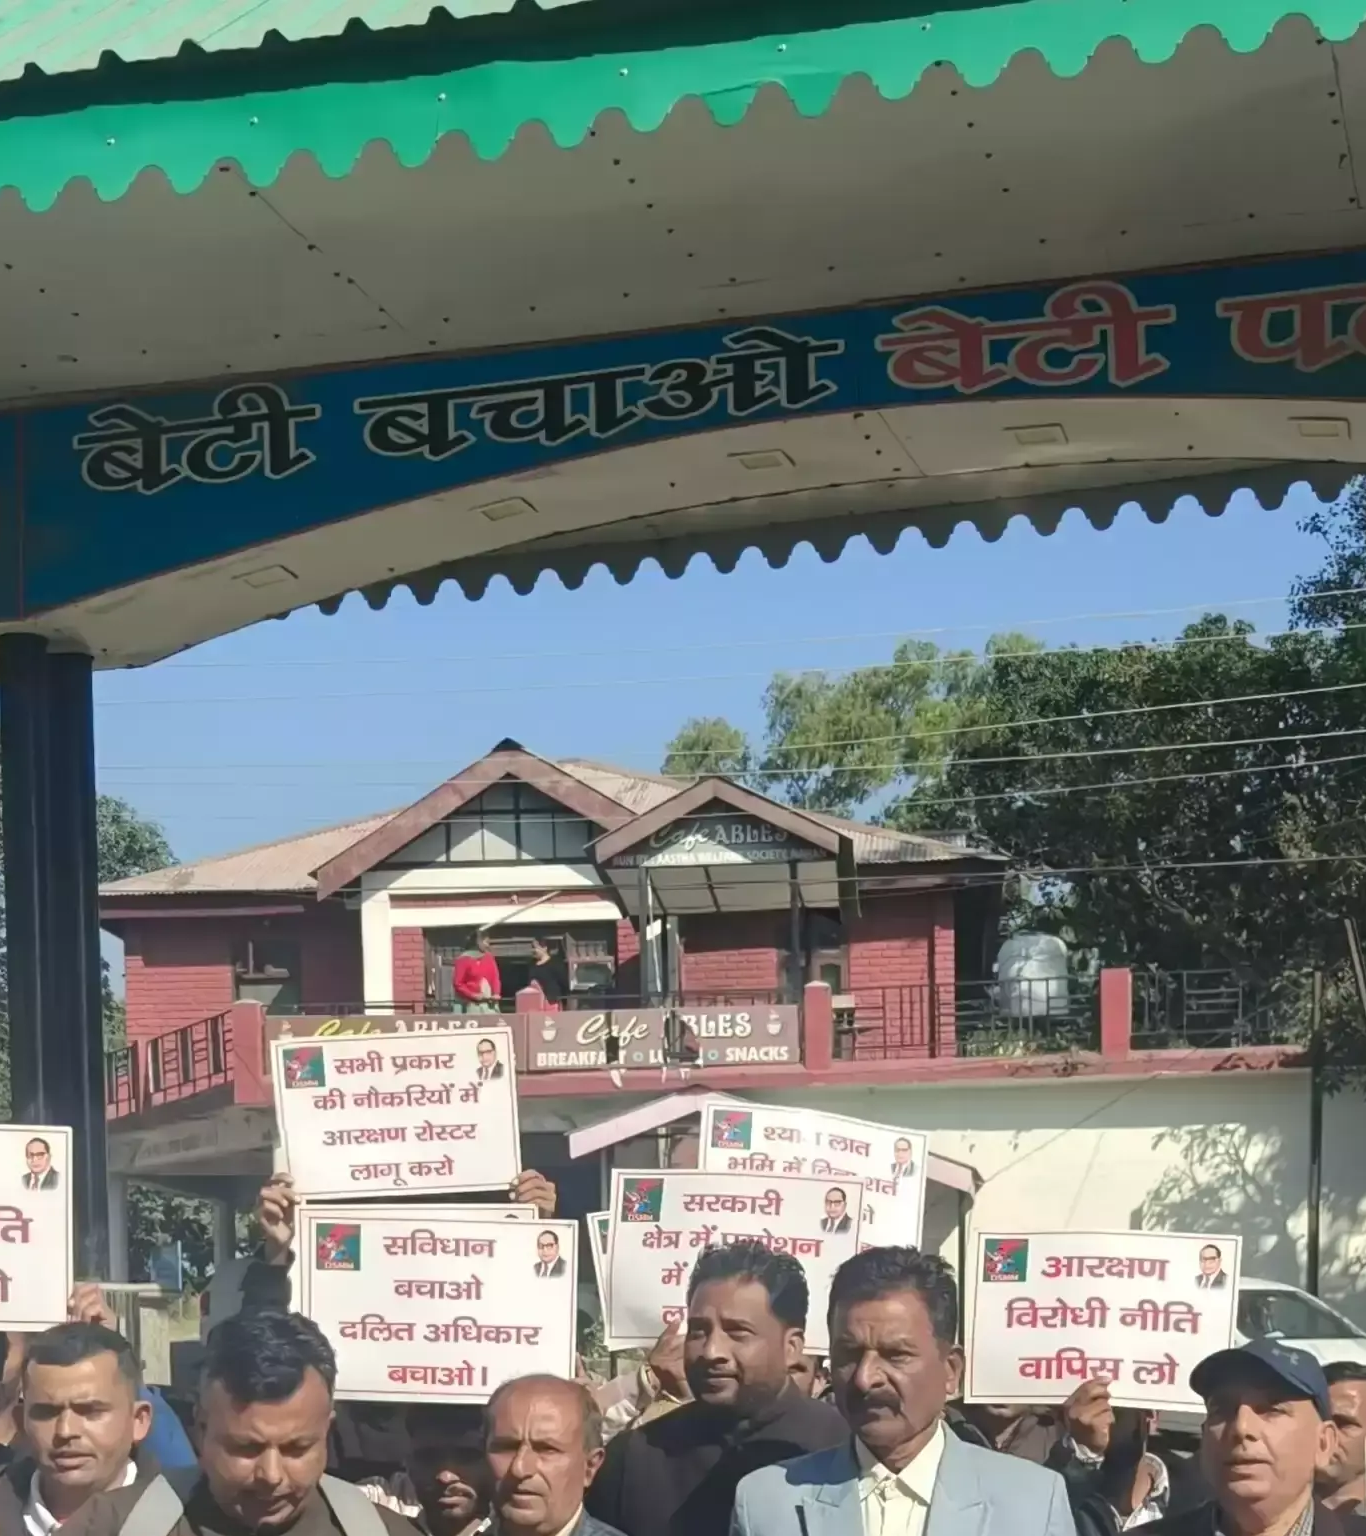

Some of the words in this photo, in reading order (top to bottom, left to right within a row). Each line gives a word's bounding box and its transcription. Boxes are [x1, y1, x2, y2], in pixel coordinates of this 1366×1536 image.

[74, 383, 321, 495] बेटी
[354, 326, 844, 460] बचाओ
[876, 281, 1176, 394] बेटी
[649, 819, 709, 850] Cafe
[334, 1050, 384, 1075] सभी
[391, 1052, 455, 1074] प्रकार
[725, 1046, 789, 1063] SNACKS
[313, 1088, 346, 1111] की
[353, 1083, 455, 1109] नौकरियों
[459, 1081, 484, 1104] में
[323, 1126, 407, 1146] आरक्षण
[414, 1119, 478, 1142] रोस्टर
[350, 1164, 408, 1186] लागू
[409, 1155, 454, 1177] करो
[683, 1188, 784, 1216] सरकारी
[642, 1224, 683, 1249] क्षेत्र
[689, 1224, 718, 1248] में
[662, 1261, 688, 1286] में
[1040, 1255, 1169, 1281] आरक्षण
[394, 1275, 483, 1300] बचाओ
[339, 1314, 415, 1342] दलित
[423, 1316, 542, 1346] अधिकार
[1005, 1297, 1110, 1329] विरोधी
[1119, 1299, 1203, 1335] नीति
[1018, 1347, 1124, 1381] वापिस
[1132, 1353, 1179, 1386] लो
